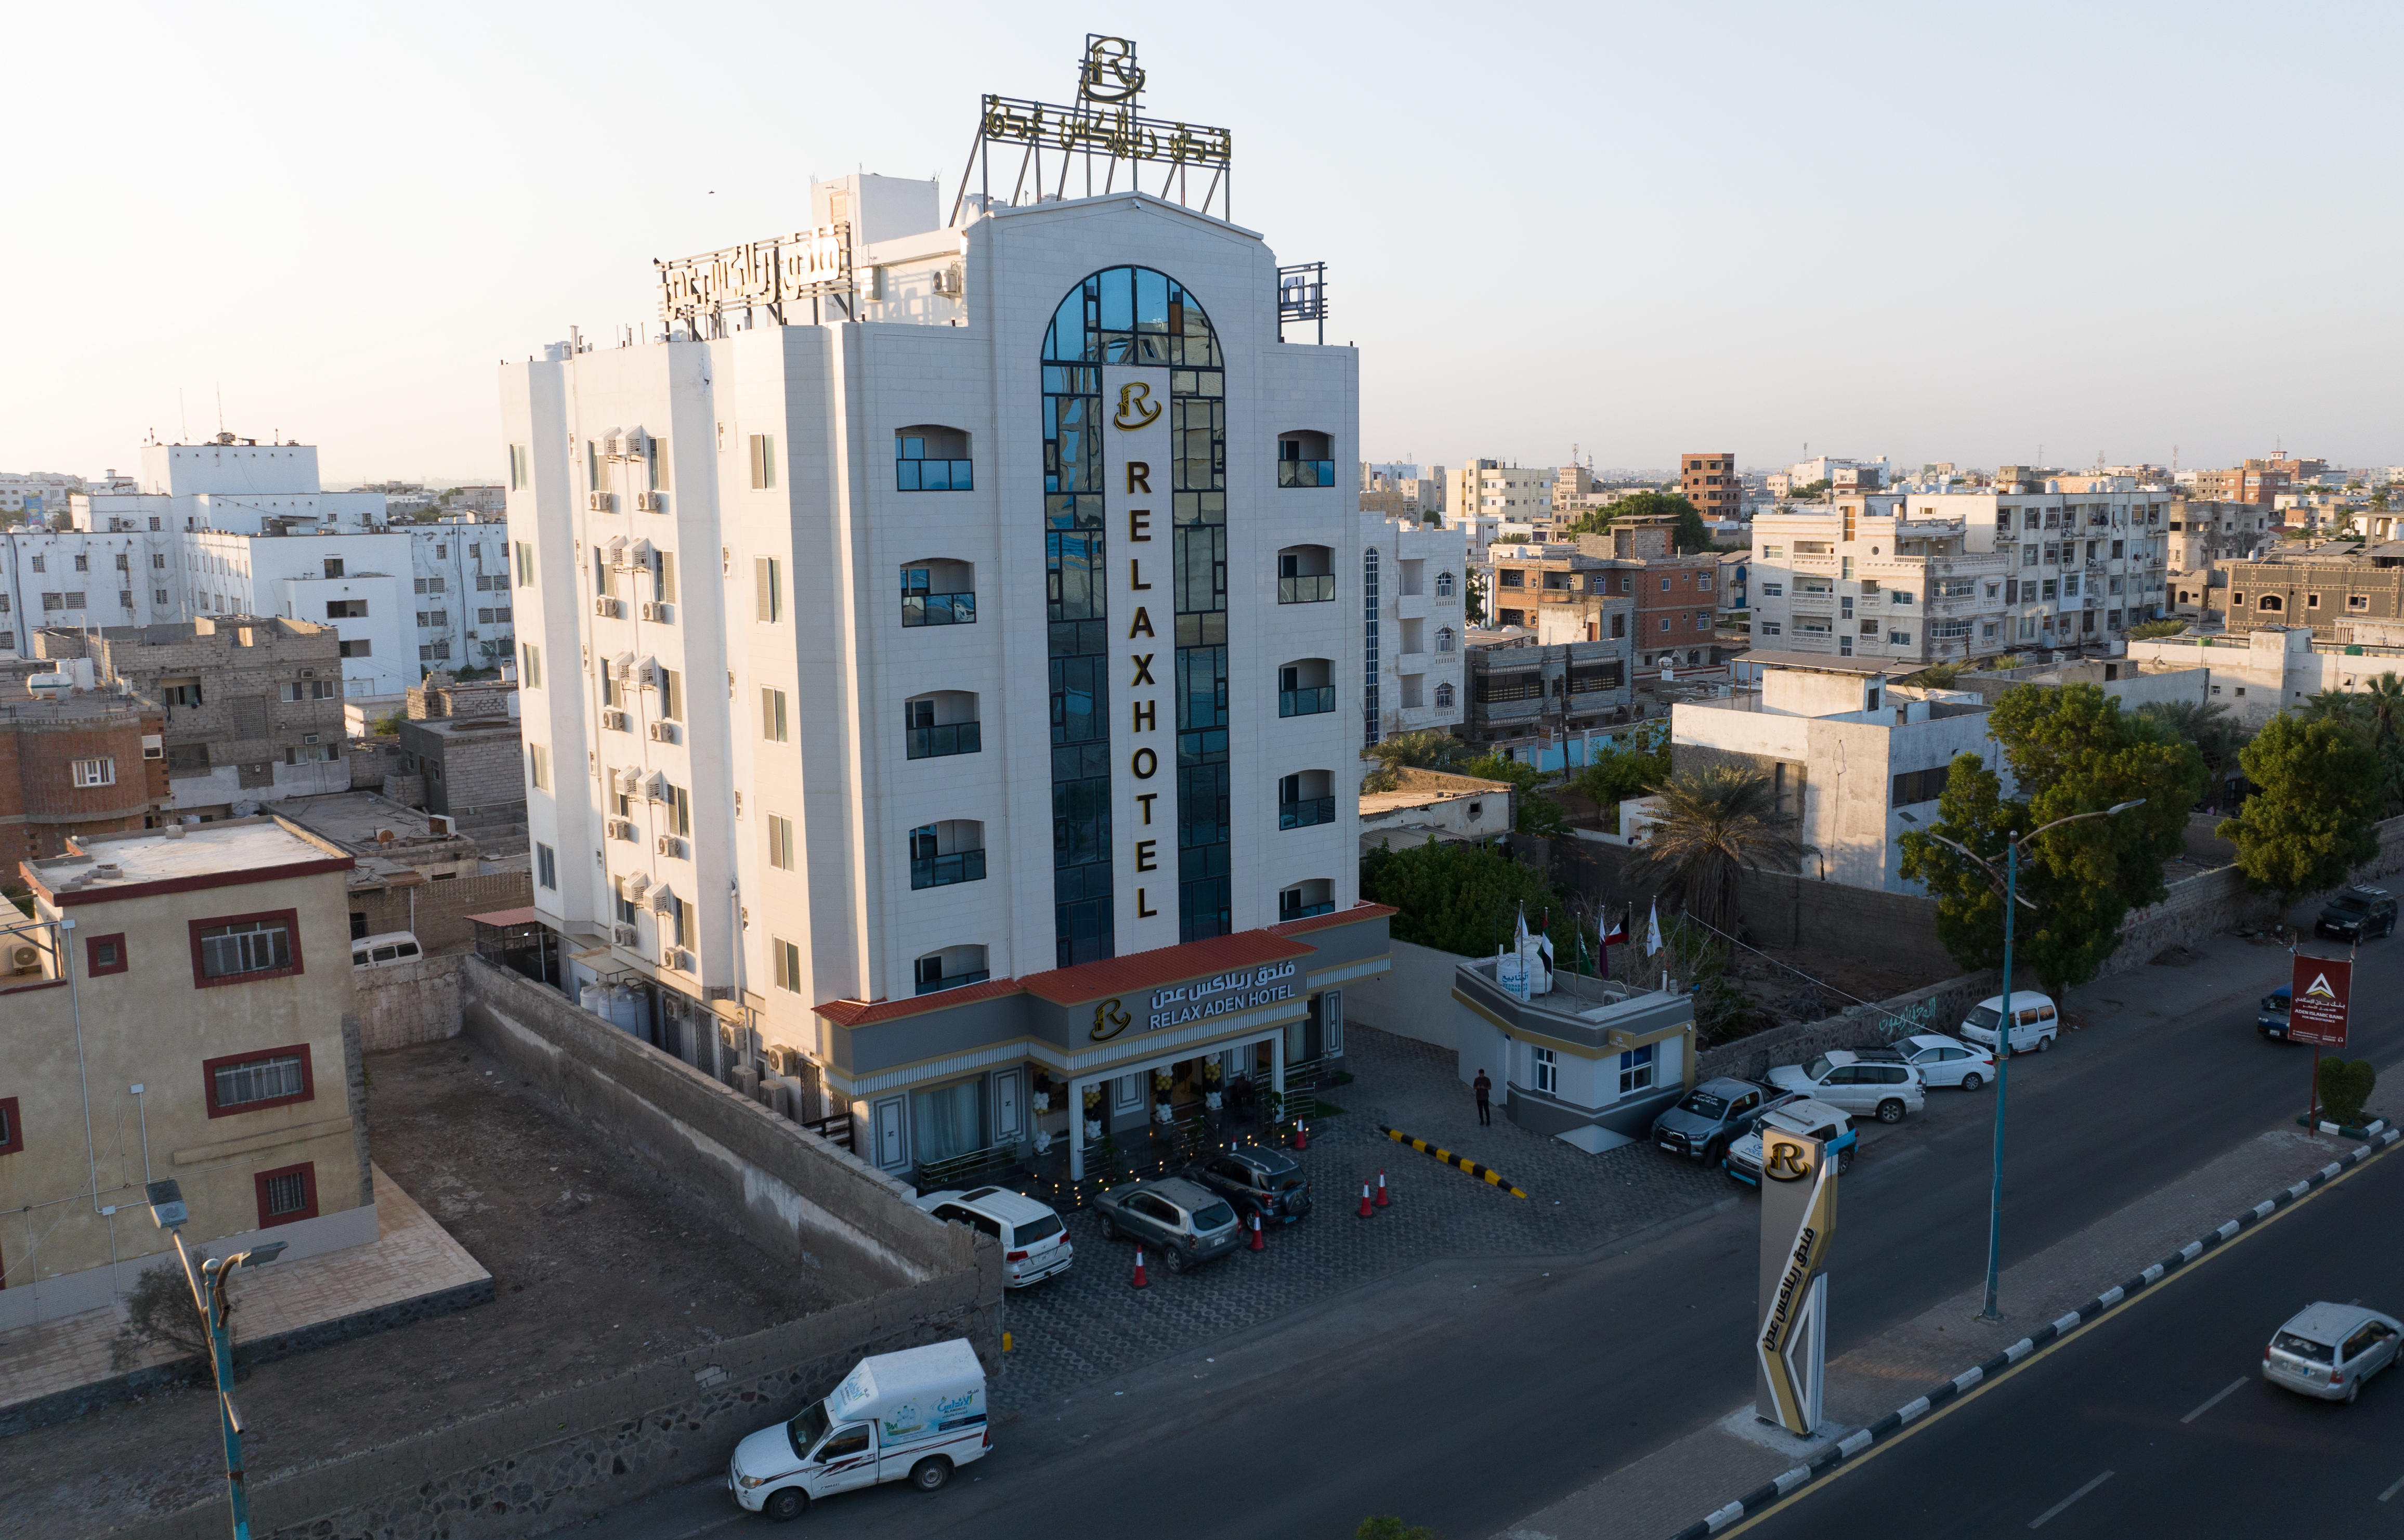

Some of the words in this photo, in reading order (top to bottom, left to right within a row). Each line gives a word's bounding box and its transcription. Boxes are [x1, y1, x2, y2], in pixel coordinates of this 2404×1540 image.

[988, 94, 1047, 140] عدن
[1059, 108, 1157, 160] ريلاكس
[1169, 122, 1231, 164] فندق
[700, 243, 778, 315] ريلاكس
[780, 224, 841, 301] فندق
[662, 262, 700, 321] عدن
[1188, 973, 1251, 1001] ريلاكس
[1255, 961, 1295, 986] فندق
[1150, 1005, 1200, 1029] RELAX
[1204, 995, 1244, 1017] ADEN
[1249, 984, 1295, 1007] HOTEL
[1152, 988, 1185, 1009] عدن
[1745, 1147, 1763, 1158] POLIC
[1794, 1226, 1816, 1268] فندق
[1775, 1265, 1804, 1323] ريلاكس
[1762, 1319, 1780, 1352] عدن
